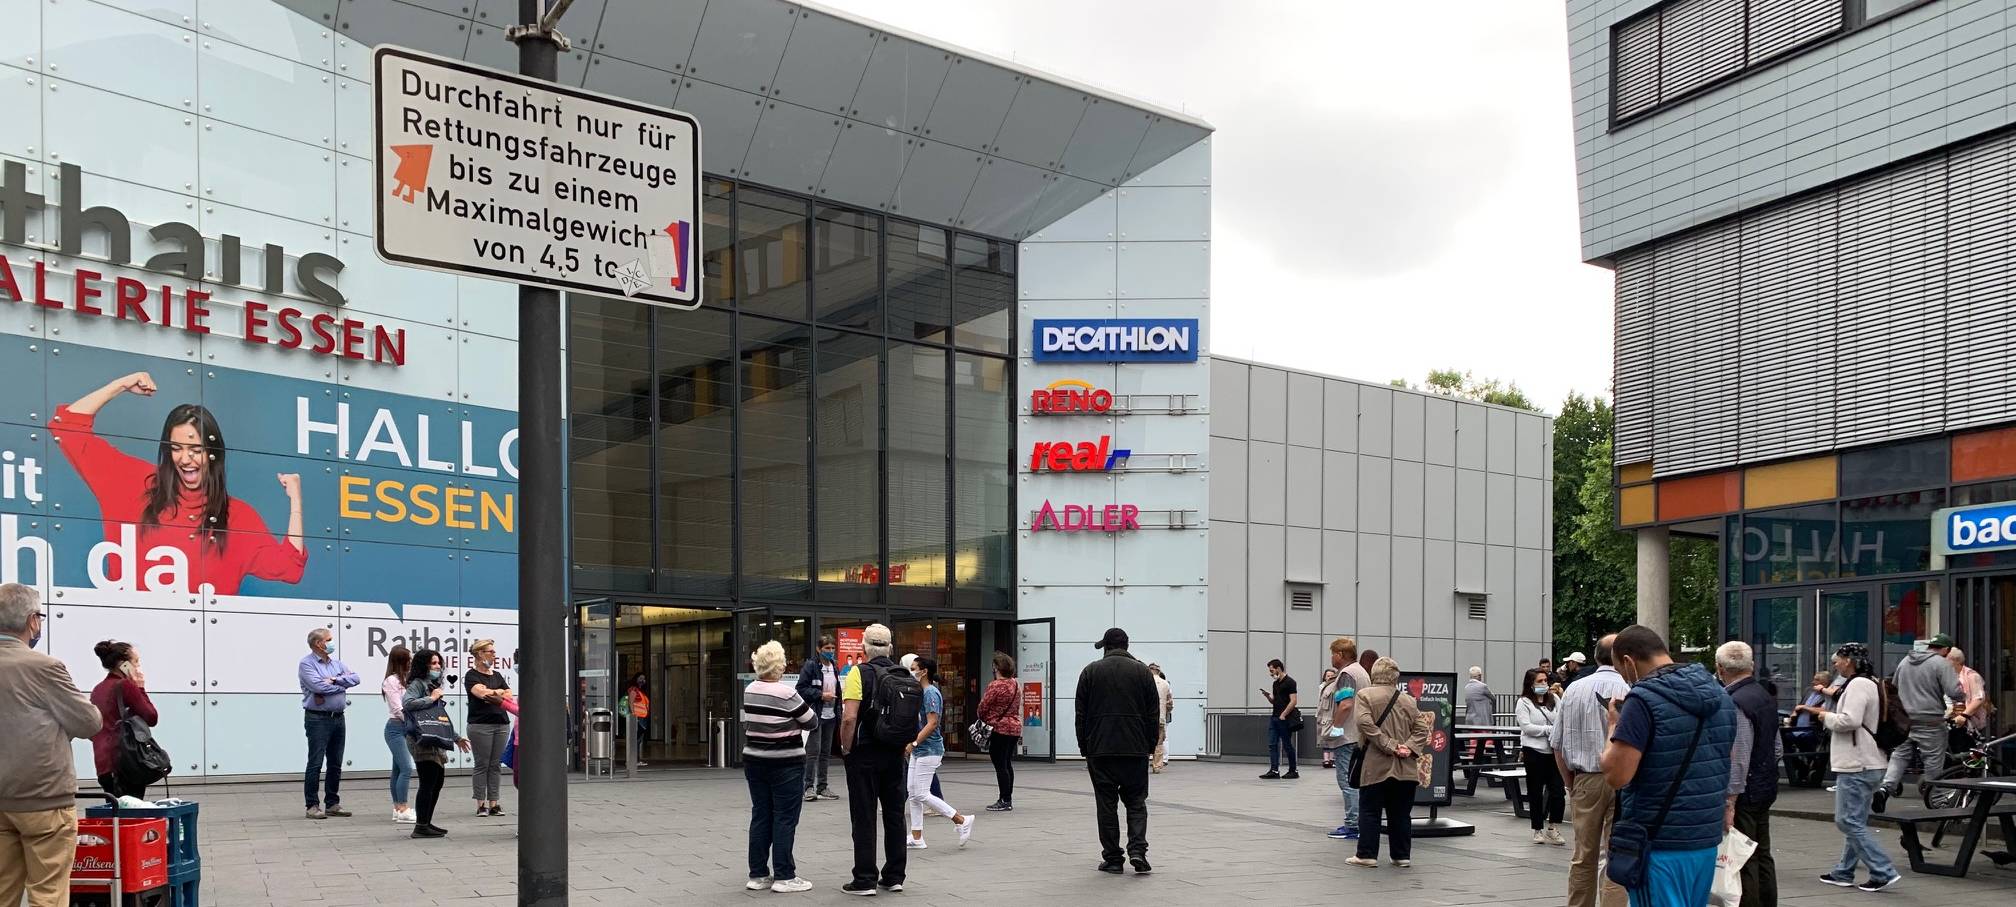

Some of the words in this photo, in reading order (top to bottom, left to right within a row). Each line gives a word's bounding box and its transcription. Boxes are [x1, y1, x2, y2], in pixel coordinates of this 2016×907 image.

[402, 69, 563, 128] Durchfahrt
[577, 114, 623, 139] nur
[637, 123, 676, 150] für
[403, 107, 677, 188] Rettungsfahrzeuge
[450, 154, 493, 184] bis
[509, 171, 540, 194] zu
[554, 178, 638, 212] einem
[473, 238, 525, 264] von
[540, 244, 580, 272] 4,5
[245, 300, 405, 367] ESSEN
[1042, 326, 1190, 352] DECATHLON
[1032, 388, 1113, 414] RENO
[1030, 435, 1111, 473] real
[340, 475, 514, 533] ESSEN
[1032, 499, 1140, 533] ADLER
[87, 523, 216, 596] da.
[1421, 683, 1449, 695] PIZZA
